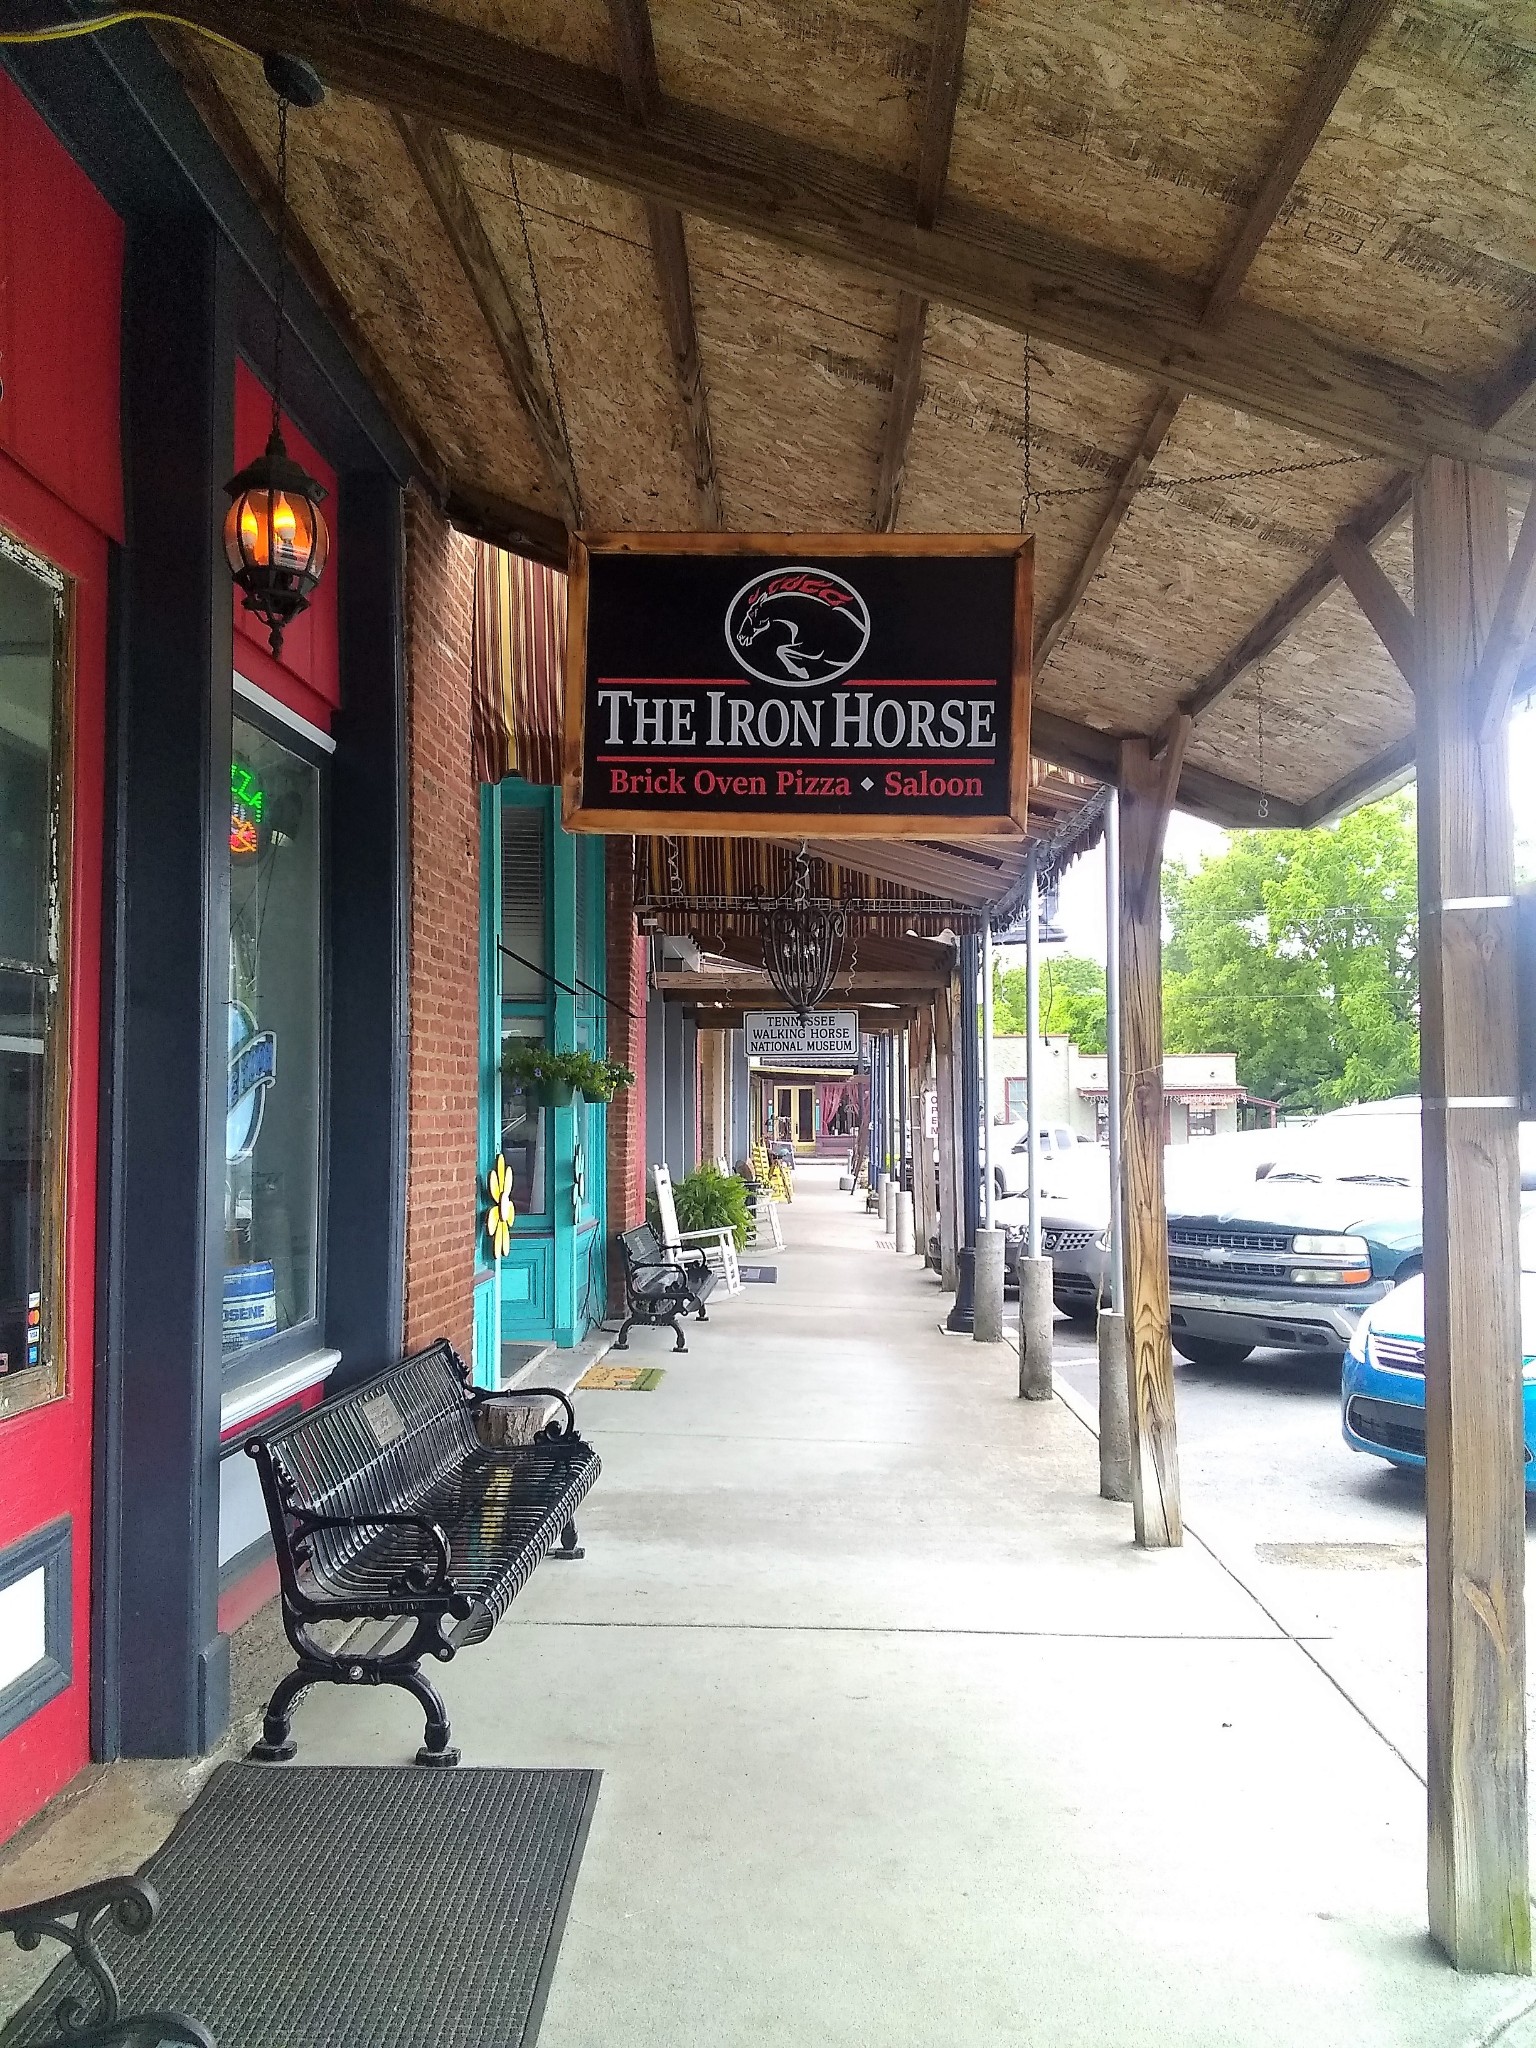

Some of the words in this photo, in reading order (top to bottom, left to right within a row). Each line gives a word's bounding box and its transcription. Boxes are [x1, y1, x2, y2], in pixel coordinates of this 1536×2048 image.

[597, 690, 697, 746] THE
[706, 691, 824, 748] IRON
[831, 692, 997, 748] HORSE
[610, 768, 686, 795] Brick
[694, 769, 767, 796] Oven
[776, 769, 852, 797] Pizza
[884, 770, 984, 797] Saloon
[766, 1016, 836, 1027] TENNSSEE
[752, 1028, 806, 1040] WALKING
[810, 1028, 850, 1039] HORSE
[750, 1041, 803, 1052] NATIONAL
[807, 1040, 852, 1051] MUSEUM
